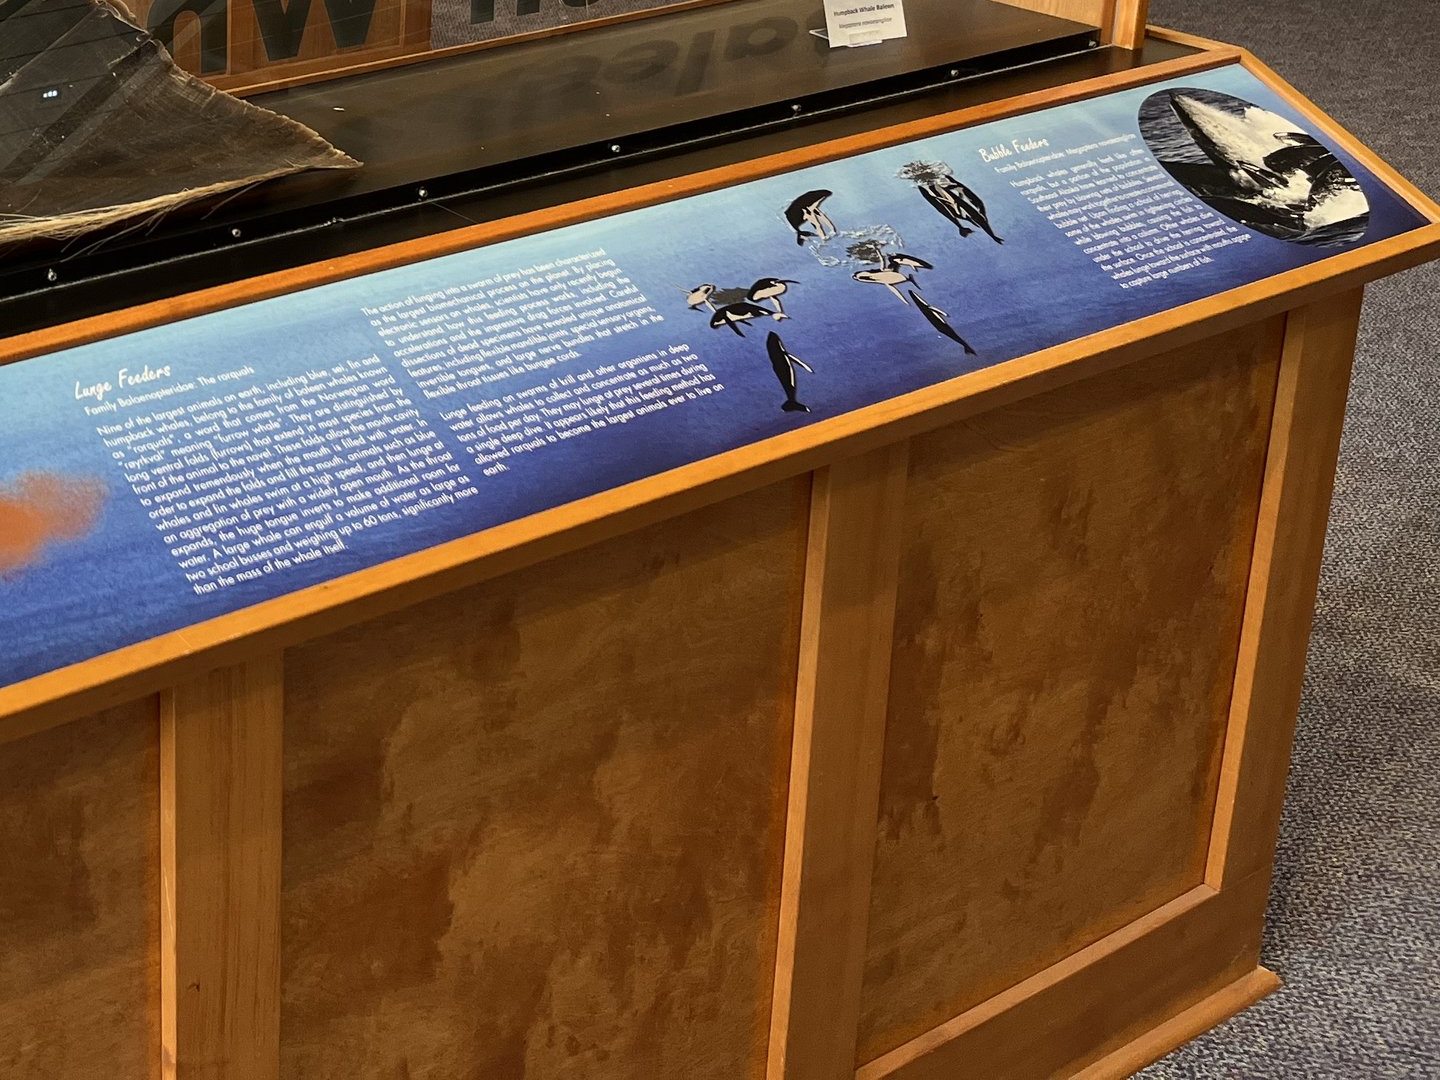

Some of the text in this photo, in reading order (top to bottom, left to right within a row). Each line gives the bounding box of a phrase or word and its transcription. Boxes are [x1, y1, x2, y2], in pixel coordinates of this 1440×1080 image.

[860, 5, 875, 13] Whale
[876, 3, 895, 11] Baleen
[978, 144, 1012, 163] Bubble
[1012, 136, 1050, 154] Feeders
[74, 364, 171, 401] Lunge Feeders
[84, 401, 117, 416] Family
[197, 377, 216, 386] The
[217, 366, 255, 381] rorquals
[185, 570, 206, 582] two
[207, 558, 240, 576] school
[273, 542, 294, 555] and
[293, 530, 340, 548] weighing
[338, 526, 353, 536] up
[351, 522, 363, 531] to
[363, 516, 378, 527] 60
[454, 487, 478, 499] more
